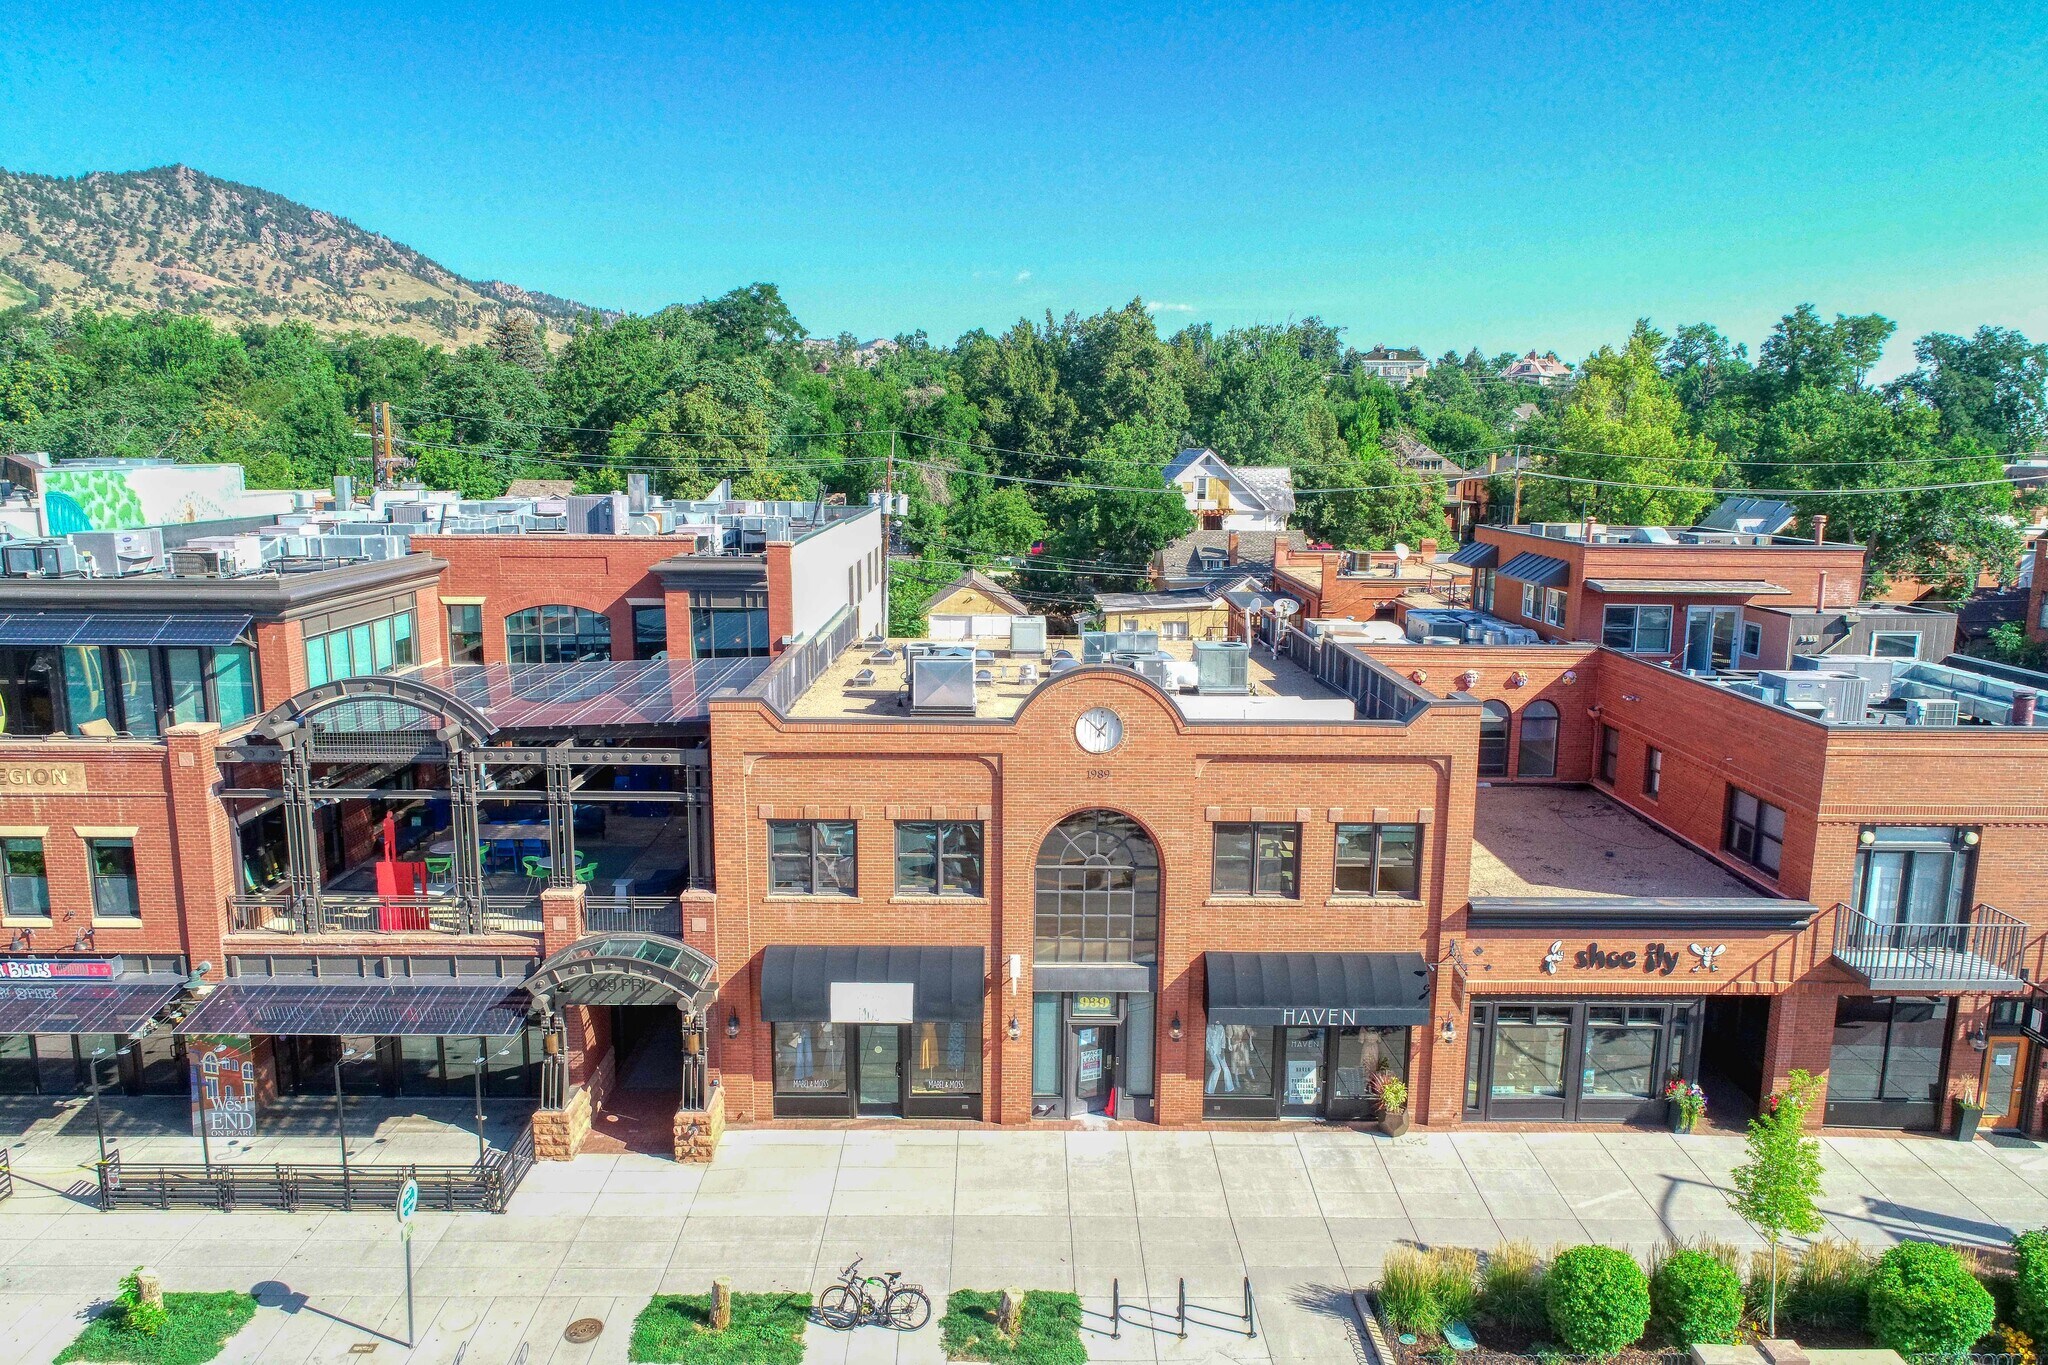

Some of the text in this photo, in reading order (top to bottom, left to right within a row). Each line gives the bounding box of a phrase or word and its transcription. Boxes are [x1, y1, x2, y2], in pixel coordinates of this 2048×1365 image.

[1086, 769, 1111, 780] 1989
[1574, 942, 1637, 970] shoe
[1079, 996, 1110, 1009] 939
[1283, 1008, 1356, 1026] HAVEN
[1291, 1040, 1319, 1048] HAVEN
[928, 1080, 944, 1088] MABEL
[949, 1080, 964, 1089] MOSS
[211, 1112, 254, 1130] END
